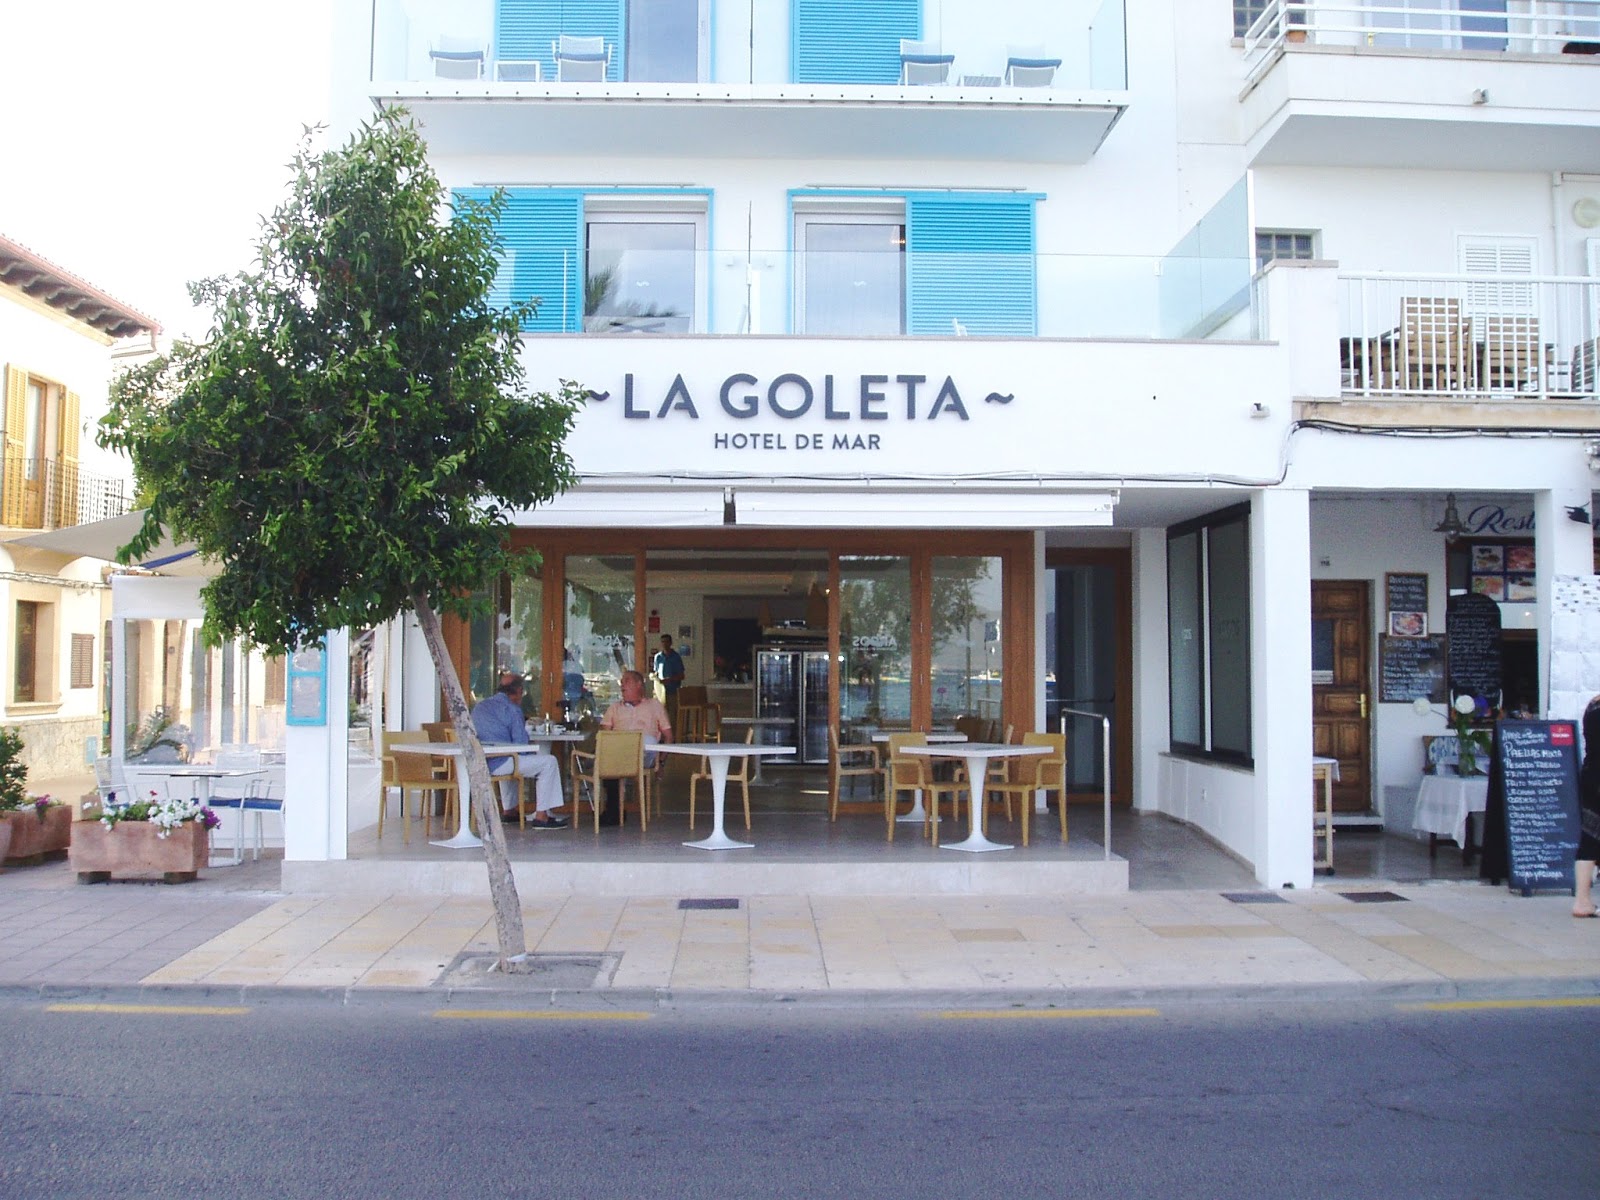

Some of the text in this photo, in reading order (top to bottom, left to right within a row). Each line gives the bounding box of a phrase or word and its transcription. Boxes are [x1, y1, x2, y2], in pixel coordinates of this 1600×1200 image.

[624, 373, 970, 421] LA GOLETA
[714, 432, 881, 451] HOTEL DE MAR
[1468, 504, 1536, 535] Rest
